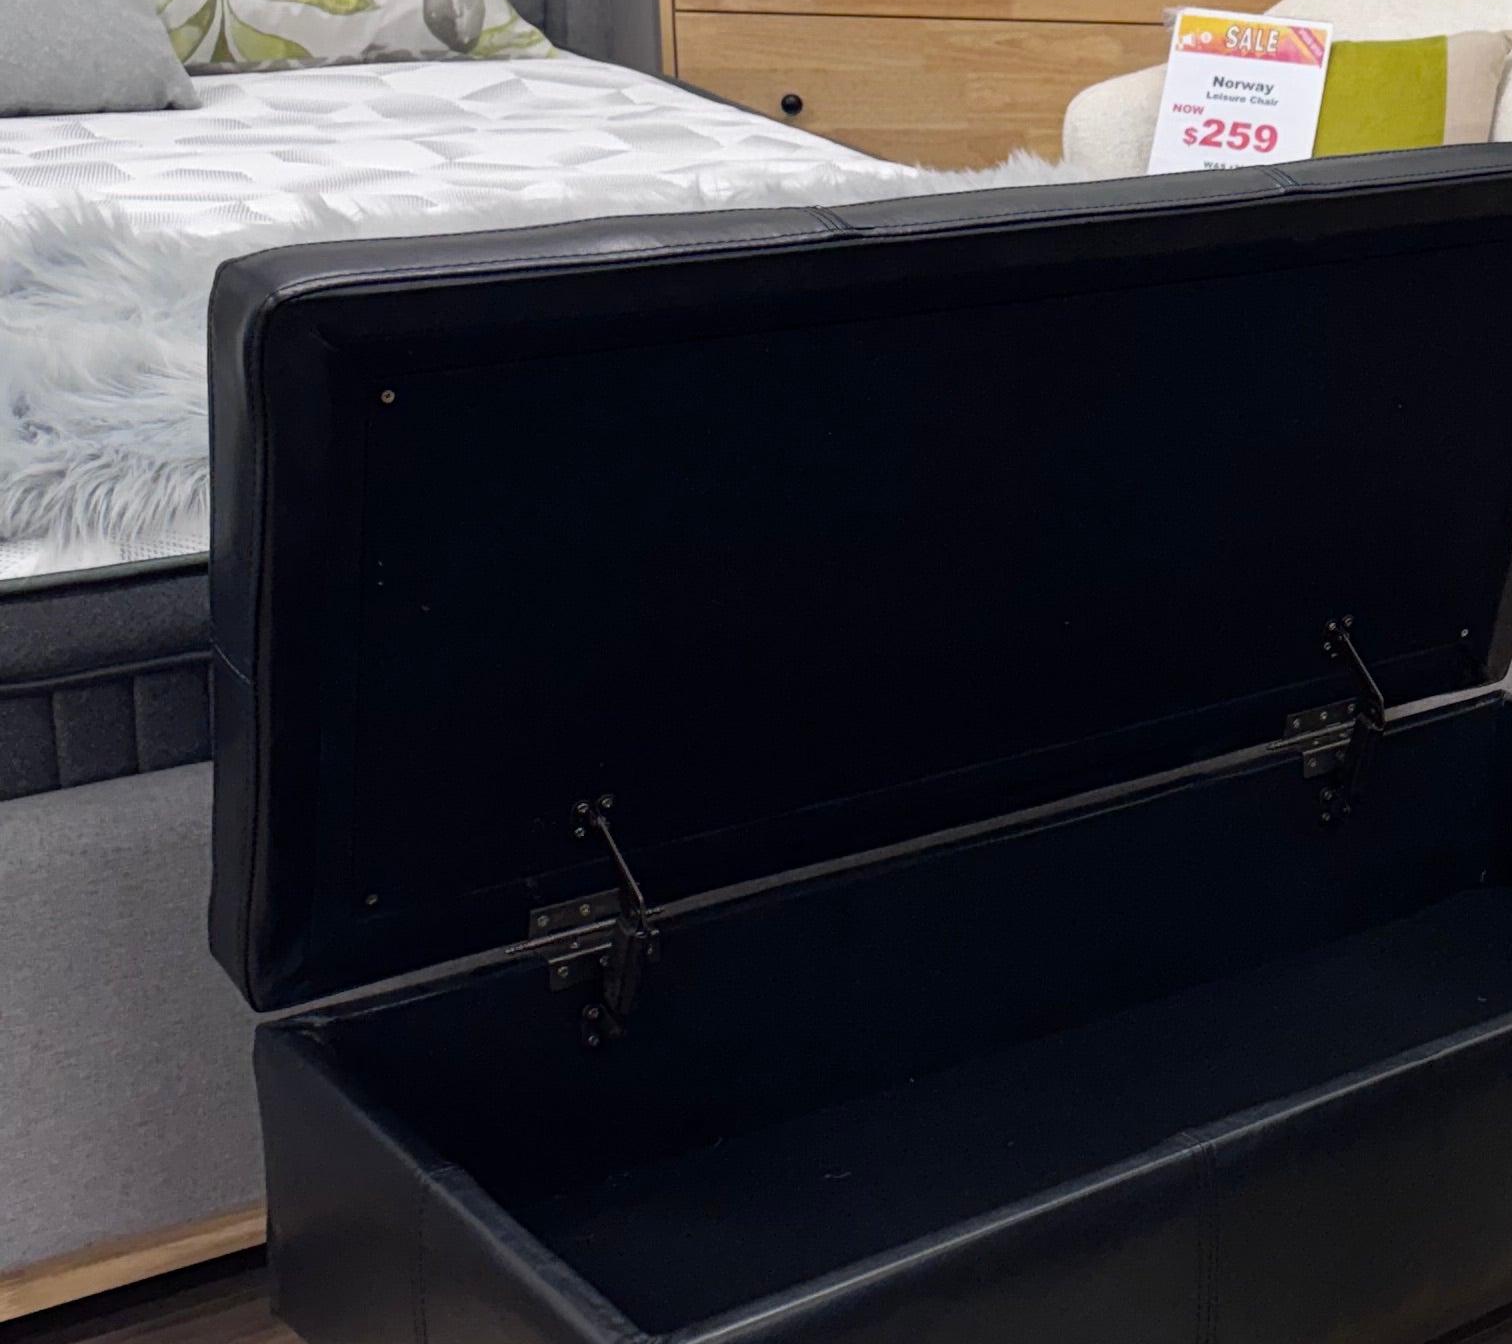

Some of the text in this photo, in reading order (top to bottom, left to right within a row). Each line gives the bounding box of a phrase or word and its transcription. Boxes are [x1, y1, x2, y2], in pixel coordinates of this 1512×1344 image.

[1225, 25, 1280, 53] SALE
[1212, 76, 1275, 95] Norway
[1206, 91, 1279, 107] Leisure Chair
[1173, 104, 1204, 115] NOW
[1183, 118, 1279, 154] $259
